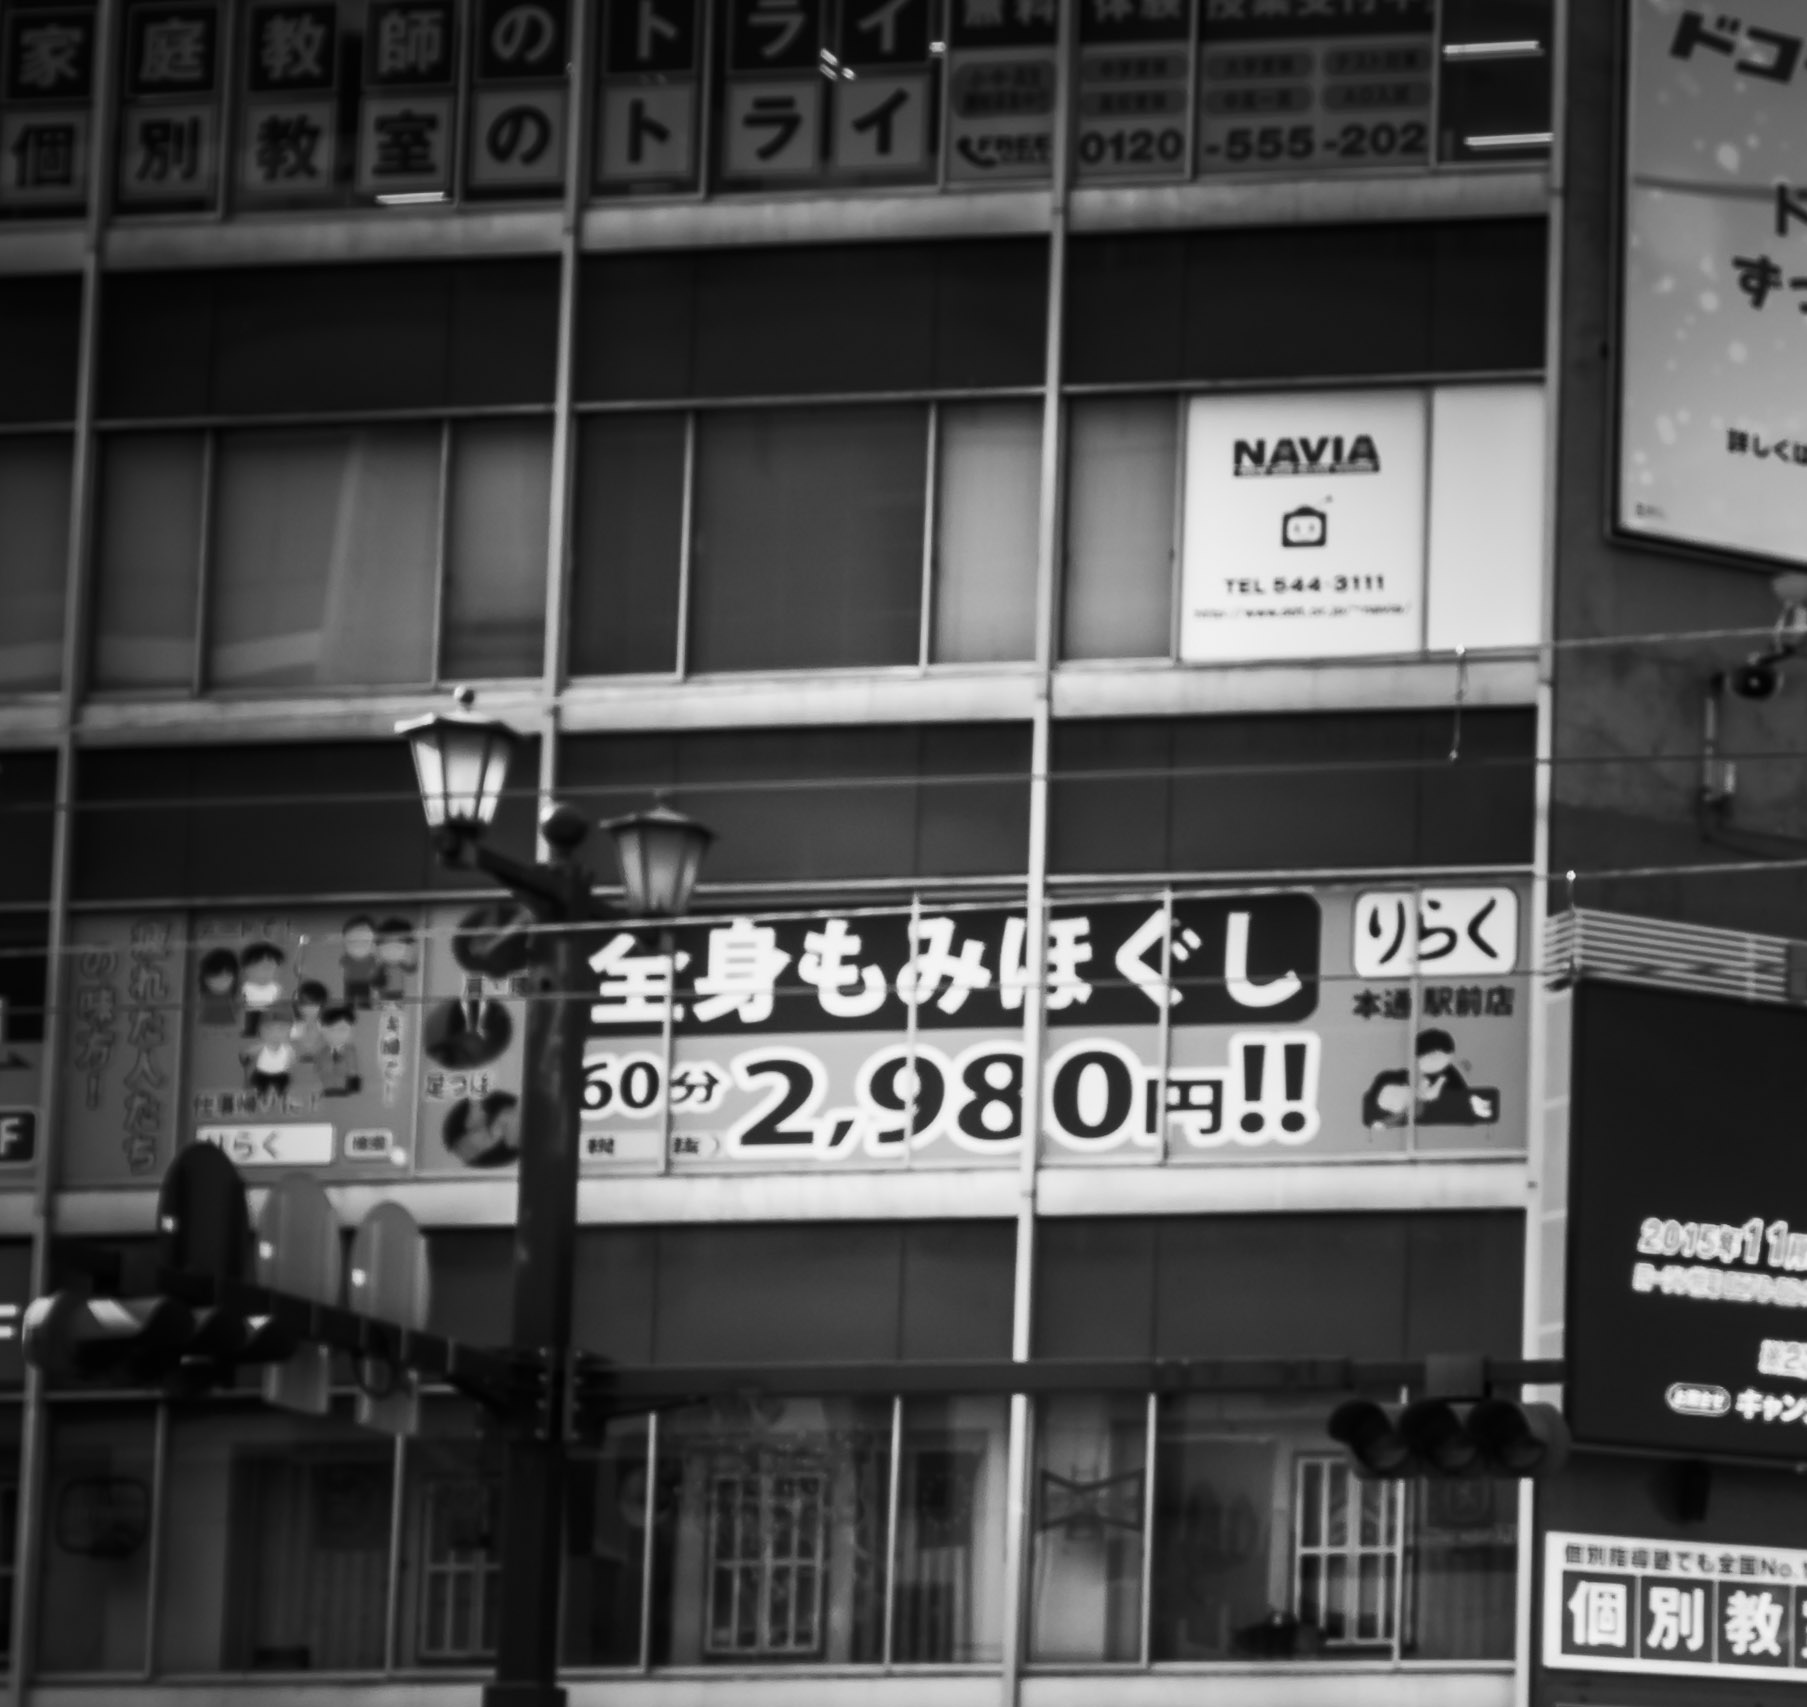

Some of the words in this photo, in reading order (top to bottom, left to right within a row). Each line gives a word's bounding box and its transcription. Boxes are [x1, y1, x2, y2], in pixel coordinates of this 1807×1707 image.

[12, 88, 911, 190] 個別教室のトライ
[1080, 121, 1427, 164] 0120-555-202
[1233, 434, 1380, 476] NAVIA
[587, 908, 1302, 1025] 全身もみほぐし
